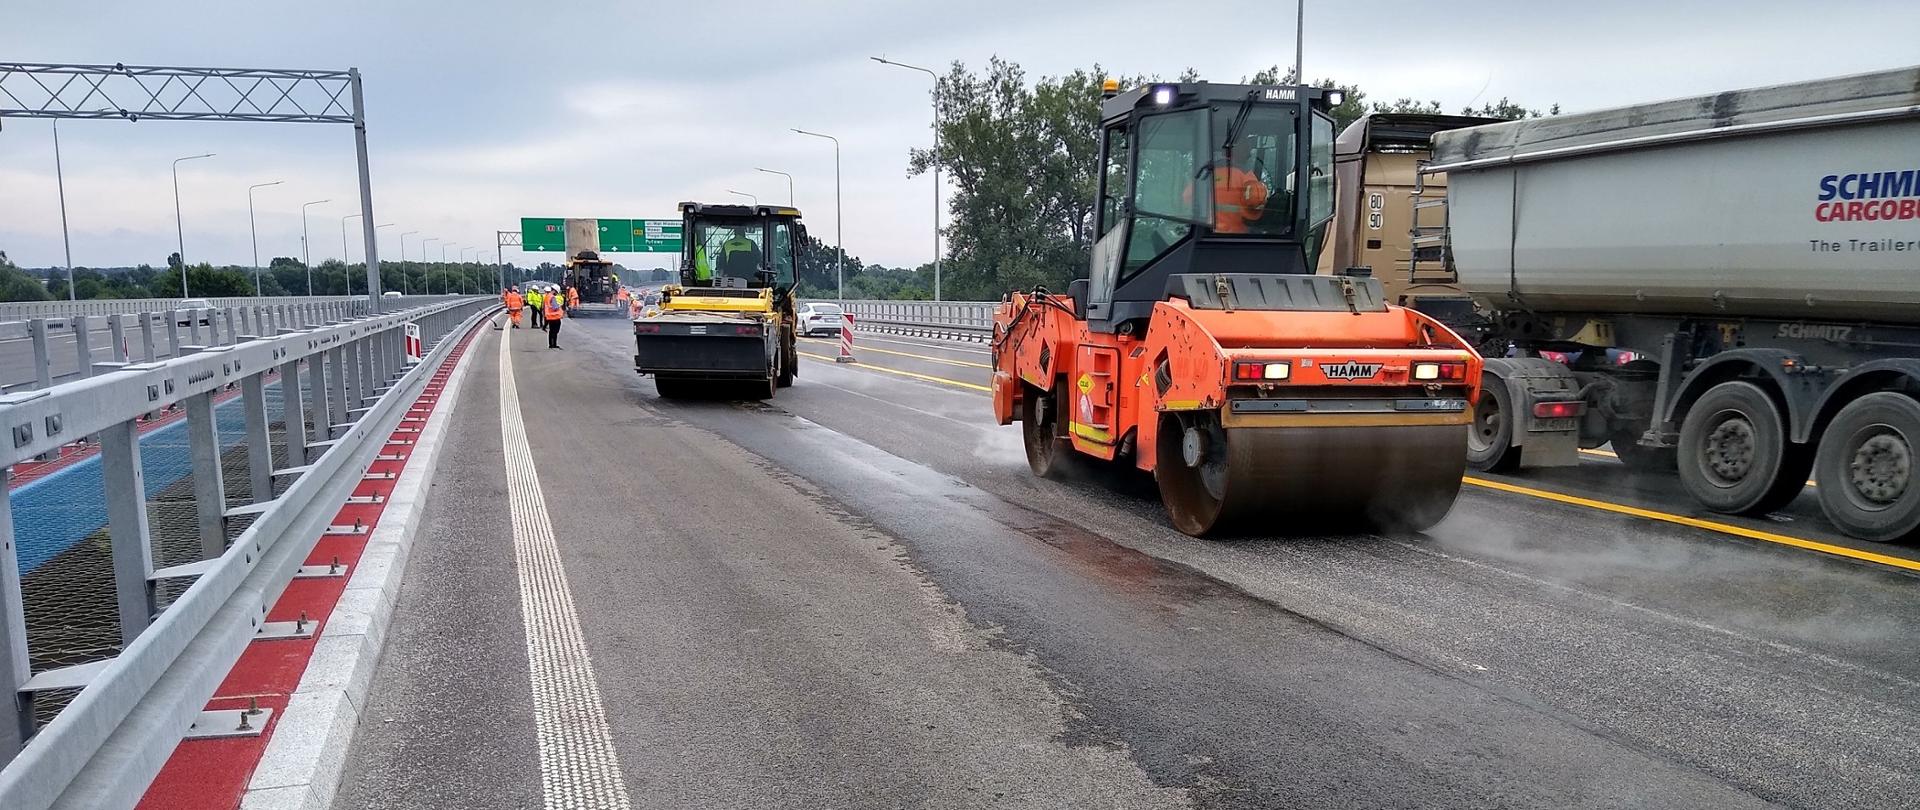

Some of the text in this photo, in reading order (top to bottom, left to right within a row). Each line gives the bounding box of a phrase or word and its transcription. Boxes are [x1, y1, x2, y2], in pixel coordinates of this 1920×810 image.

[1265, 89, 1296, 100] HAMM
[1370, 194, 1382, 209] 80
[1815, 200, 1920, 222] CARGOB
[1370, 213, 1381, 228] 90
[1810, 238, 1920, 252] The Trailer
[1778, 322, 1852, 340] SCHMITZ
[1329, 365, 1373, 377] HAMM
